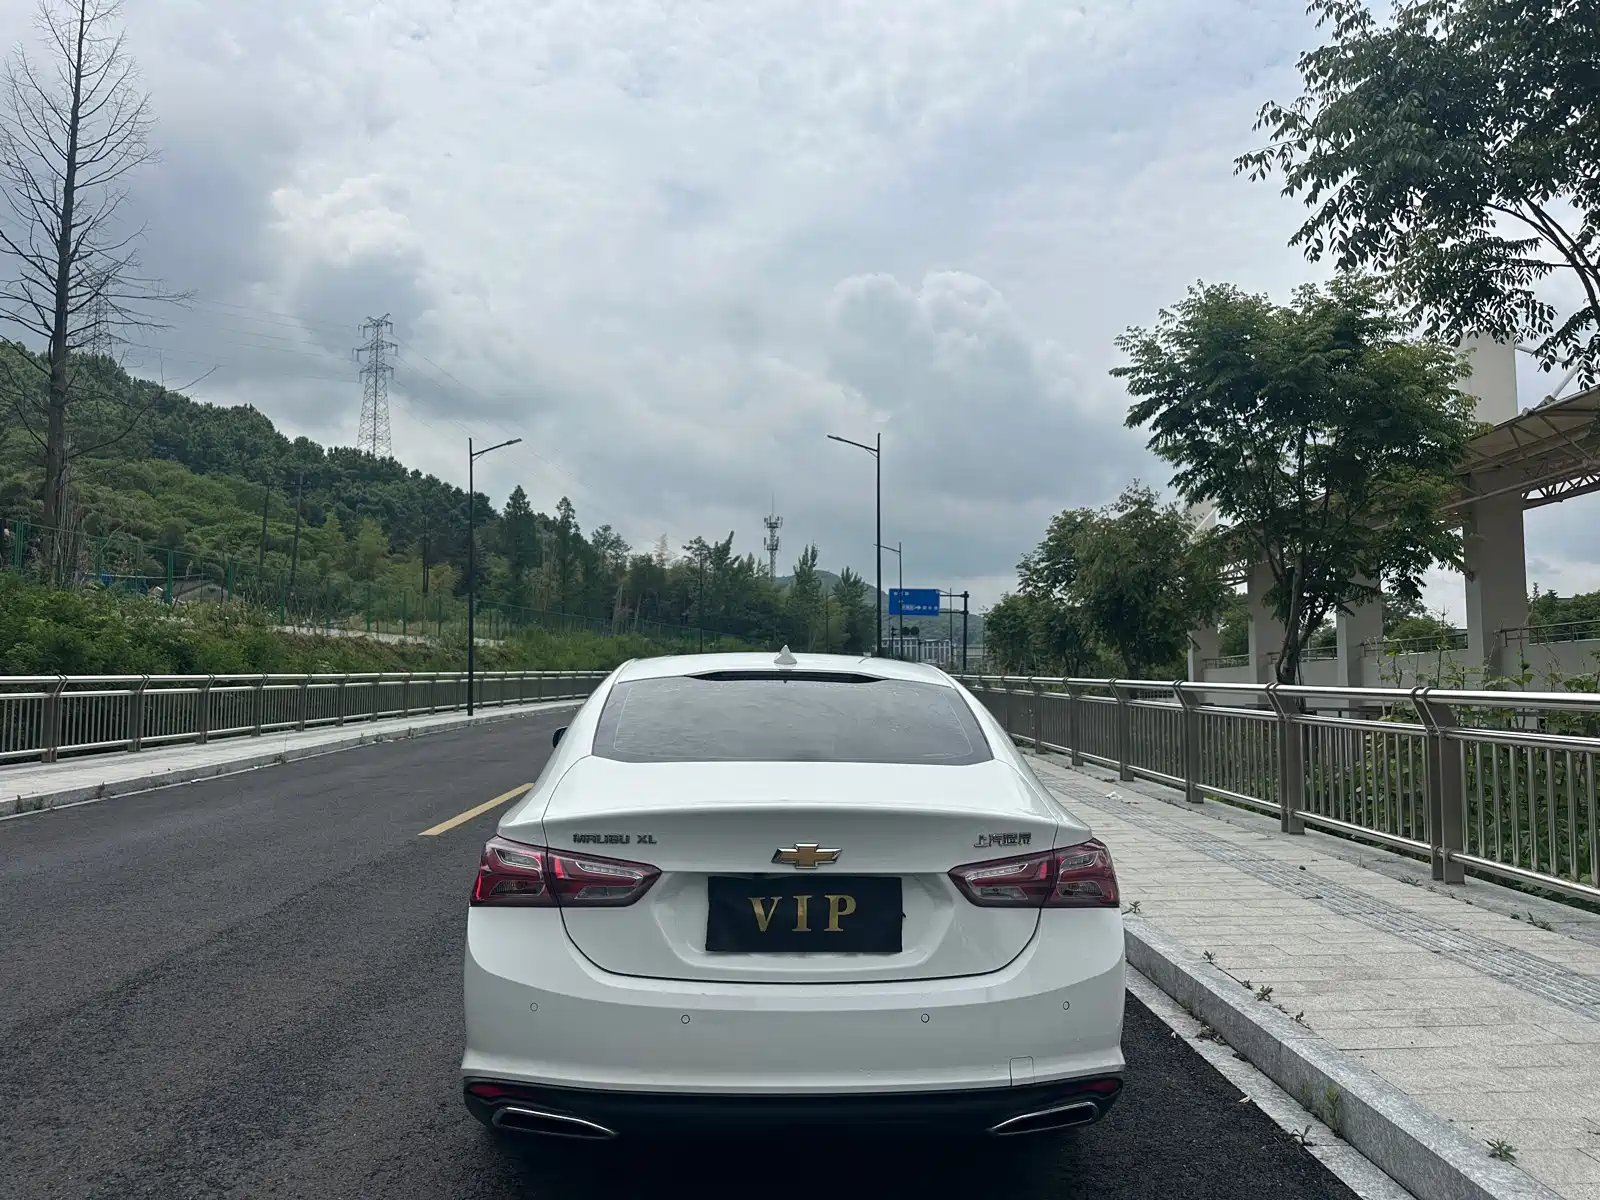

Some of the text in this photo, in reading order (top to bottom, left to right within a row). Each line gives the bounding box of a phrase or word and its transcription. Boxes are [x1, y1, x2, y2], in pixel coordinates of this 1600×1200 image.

[572, 833, 658, 845] MALIBU XL
[748, 894, 857, 933] VIP
